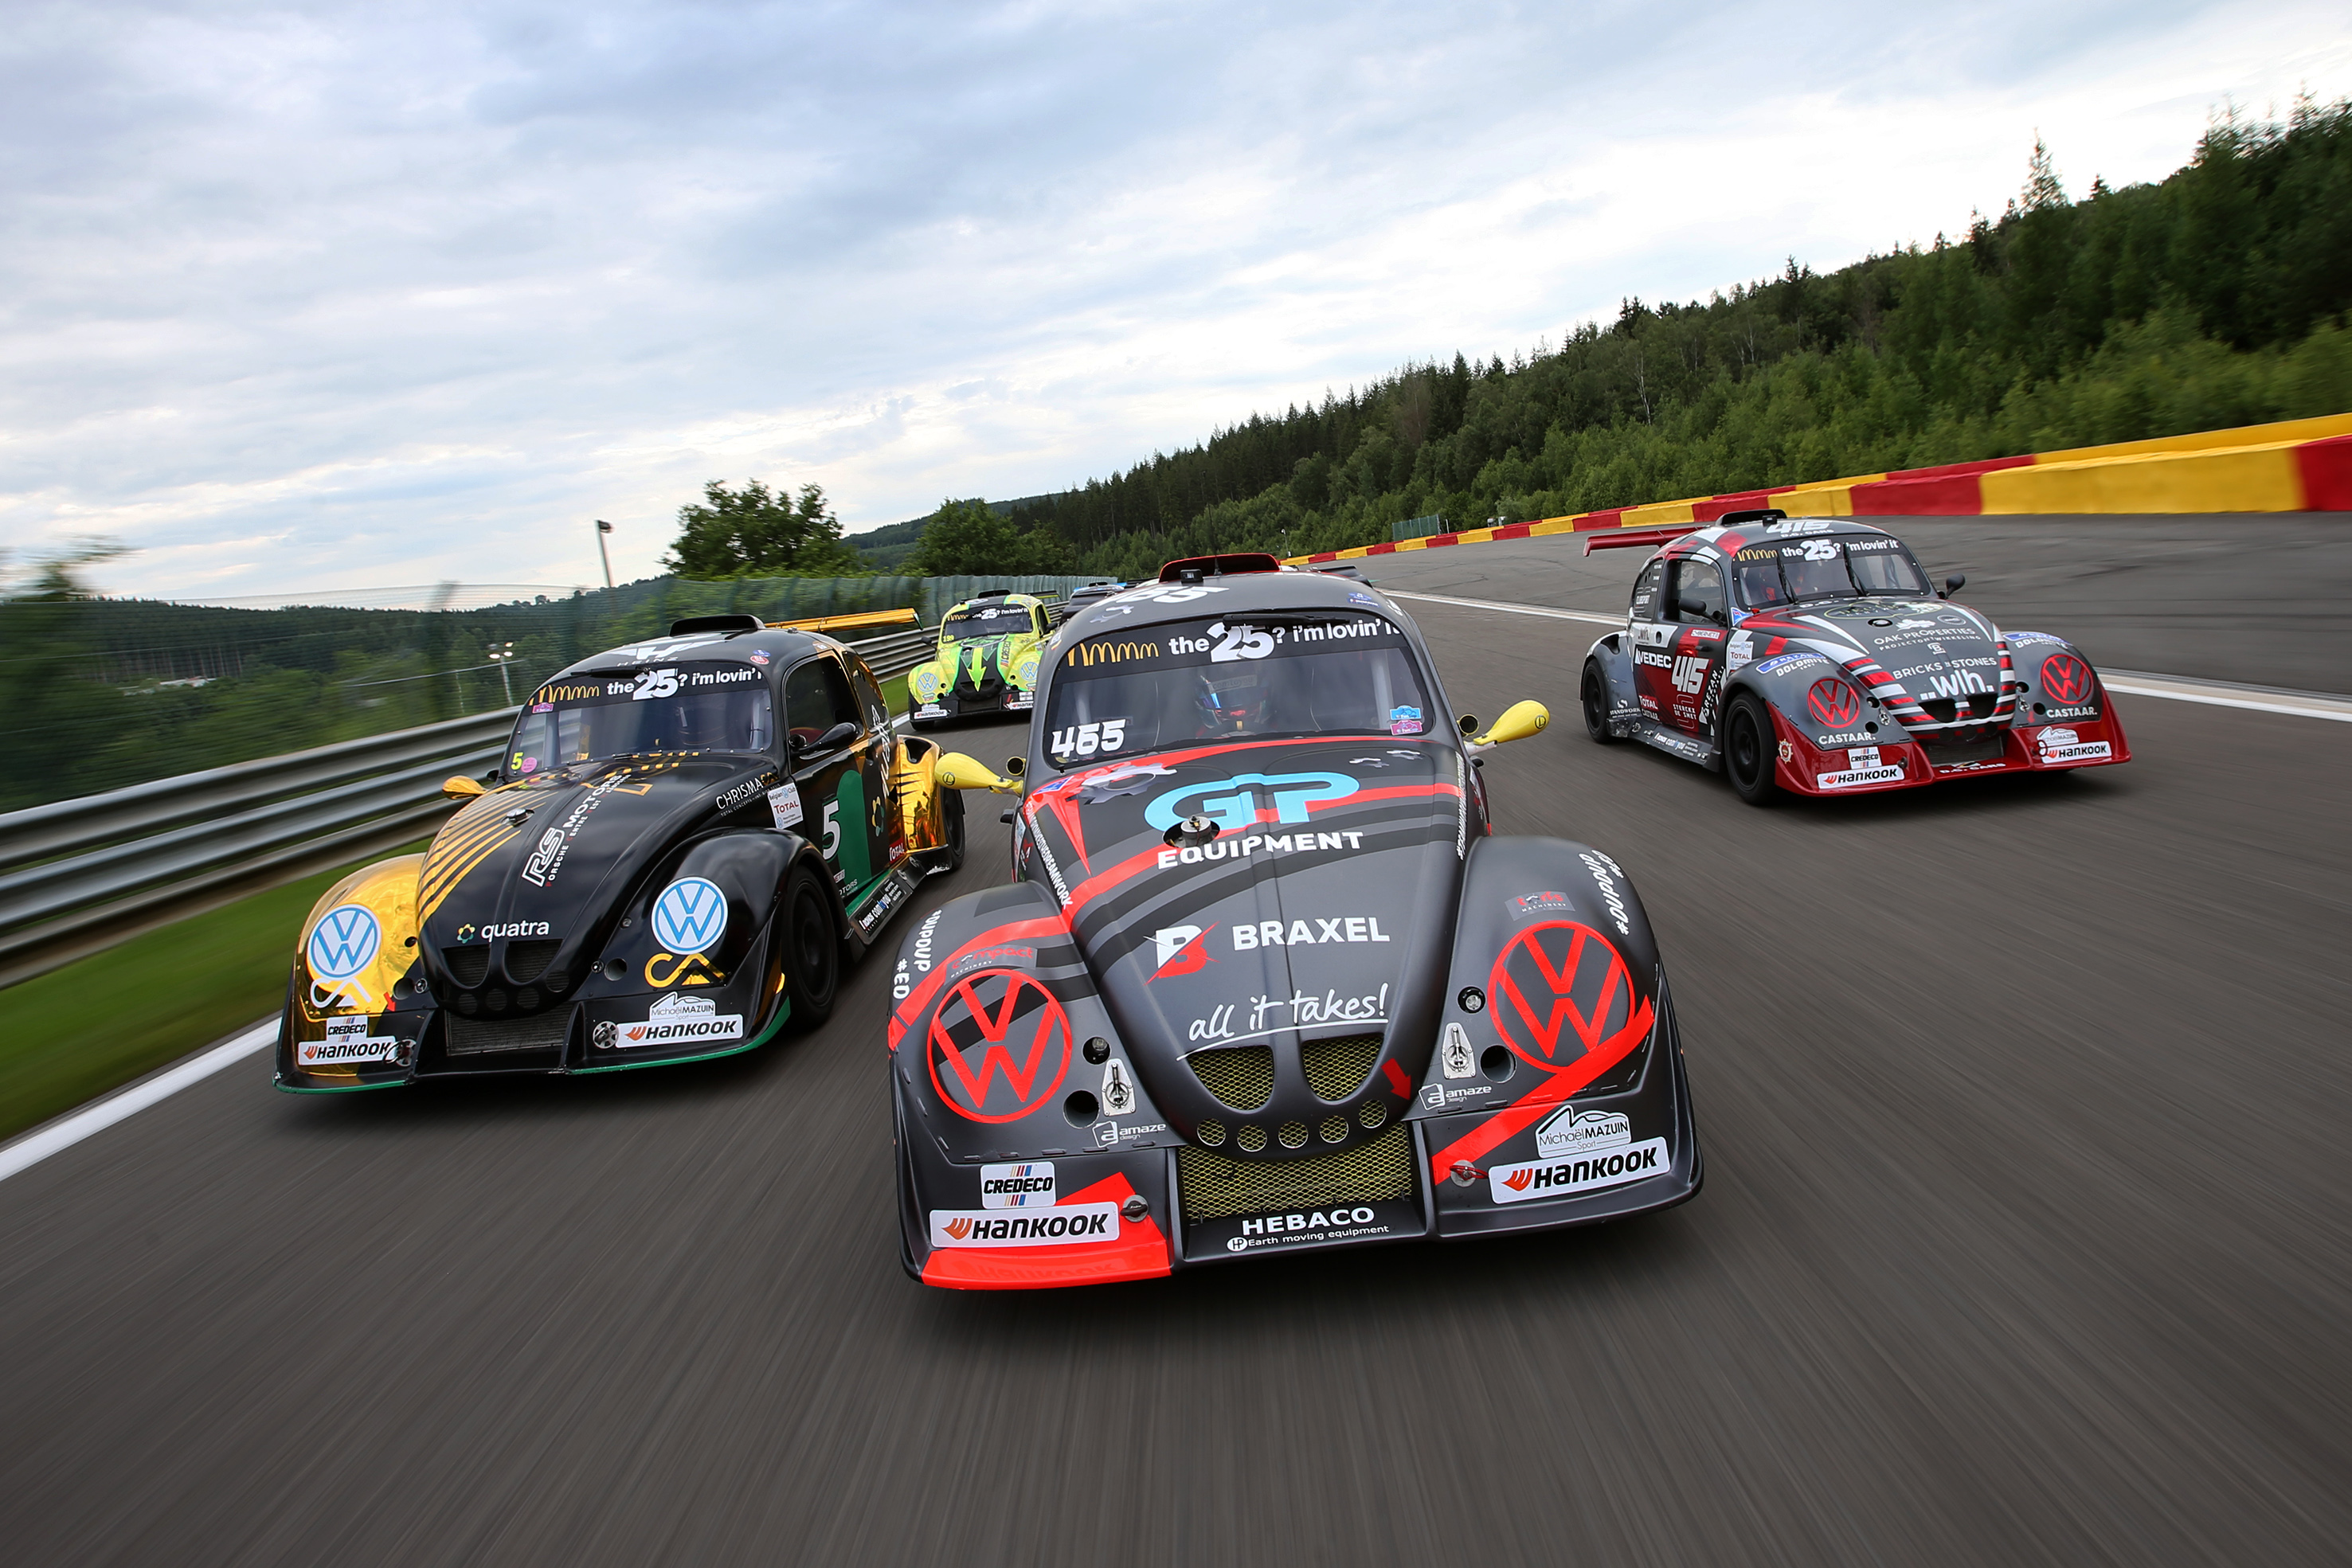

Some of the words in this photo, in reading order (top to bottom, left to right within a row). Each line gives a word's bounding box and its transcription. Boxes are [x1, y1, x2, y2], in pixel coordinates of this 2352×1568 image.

[1782, 547, 1803, 557] the
[1861, 539, 1888, 551] lovin'
[1889, 539, 1899, 548] it
[1168, 636, 1210, 655] the
[1293, 624, 1325, 643] i'm
[1327, 618, 1381, 639] lovin'
[1874, 634, 1902, 645] OAK
[1903, 628, 1976, 641] PROPERTIES
[607, 682, 634, 696] the
[692, 672, 715, 686] i'm
[717, 667, 755, 685] lovin'
[1671, 655, 1709, 694] 415
[1775, 658, 1830, 677] DOLOMITE
[1892, 662, 1943, 679] BRICKS
[1951, 657, 1998, 669] STONES
[2041, 655, 2093, 705] VW
[1638, 694, 1658, 710] TOTAL
[1807, 678, 1860, 728] VW
[2046, 706, 2098, 718] CASTAAR.
[1051, 719, 1126, 757] 465
[1818, 732, 1876, 745] CASTAAR.
[511, 752, 523, 770] 5
[1850, 753, 1879, 762] CREDECO
[562, 775, 622, 828] MOTORS
[716, 777, 764, 810] CHRISMA
[774, 800, 799, 815] TOTAL
[1145, 772, 1360, 831] GP
[822, 799, 841, 860] 5
[522, 827, 565, 887] RS
[546, 845, 569, 886] PORSCHE
[566, 815, 588, 841] CENTRE
[889, 843, 905, 861] TOTAL
[1158, 832, 1364, 870] EQUIPMENT
[653, 878, 726, 952] VW
[1521, 903, 1567, 912] MACHINERY
[310, 906, 378, 979] VW
[481, 919, 550, 941] quatra
[914, 909, 942, 972] #DUPDUP
[1232, 917, 1391, 951] BRAXEL
[893, 958, 910, 1000] #ED
[950, 960, 992, 979] MACHINERY
[1487, 920, 1636, 1074] VW
[1188, 1003, 1235, 1041] all
[1250, 995, 1284, 1030] it
[1289, 983, 1389, 1023] takes!
[327, 1024, 366, 1035] CREDECO
[927, 968, 1073, 1124] VW
[1446, 1085, 1492, 1099] amaze
[1446, 1096, 1467, 1105] design
[1119, 1123, 1166, 1136] amaze
[1576, 1140, 1596, 1152] Sport
[984, 1176, 1054, 1194] CREDECO
[1242, 1206, 1375, 1236] HEBACO
[1248, 1236, 1278, 1247] Earth
[1282, 1232, 1324, 1243] moving
[1328, 1225, 1389, 1239] equipment
